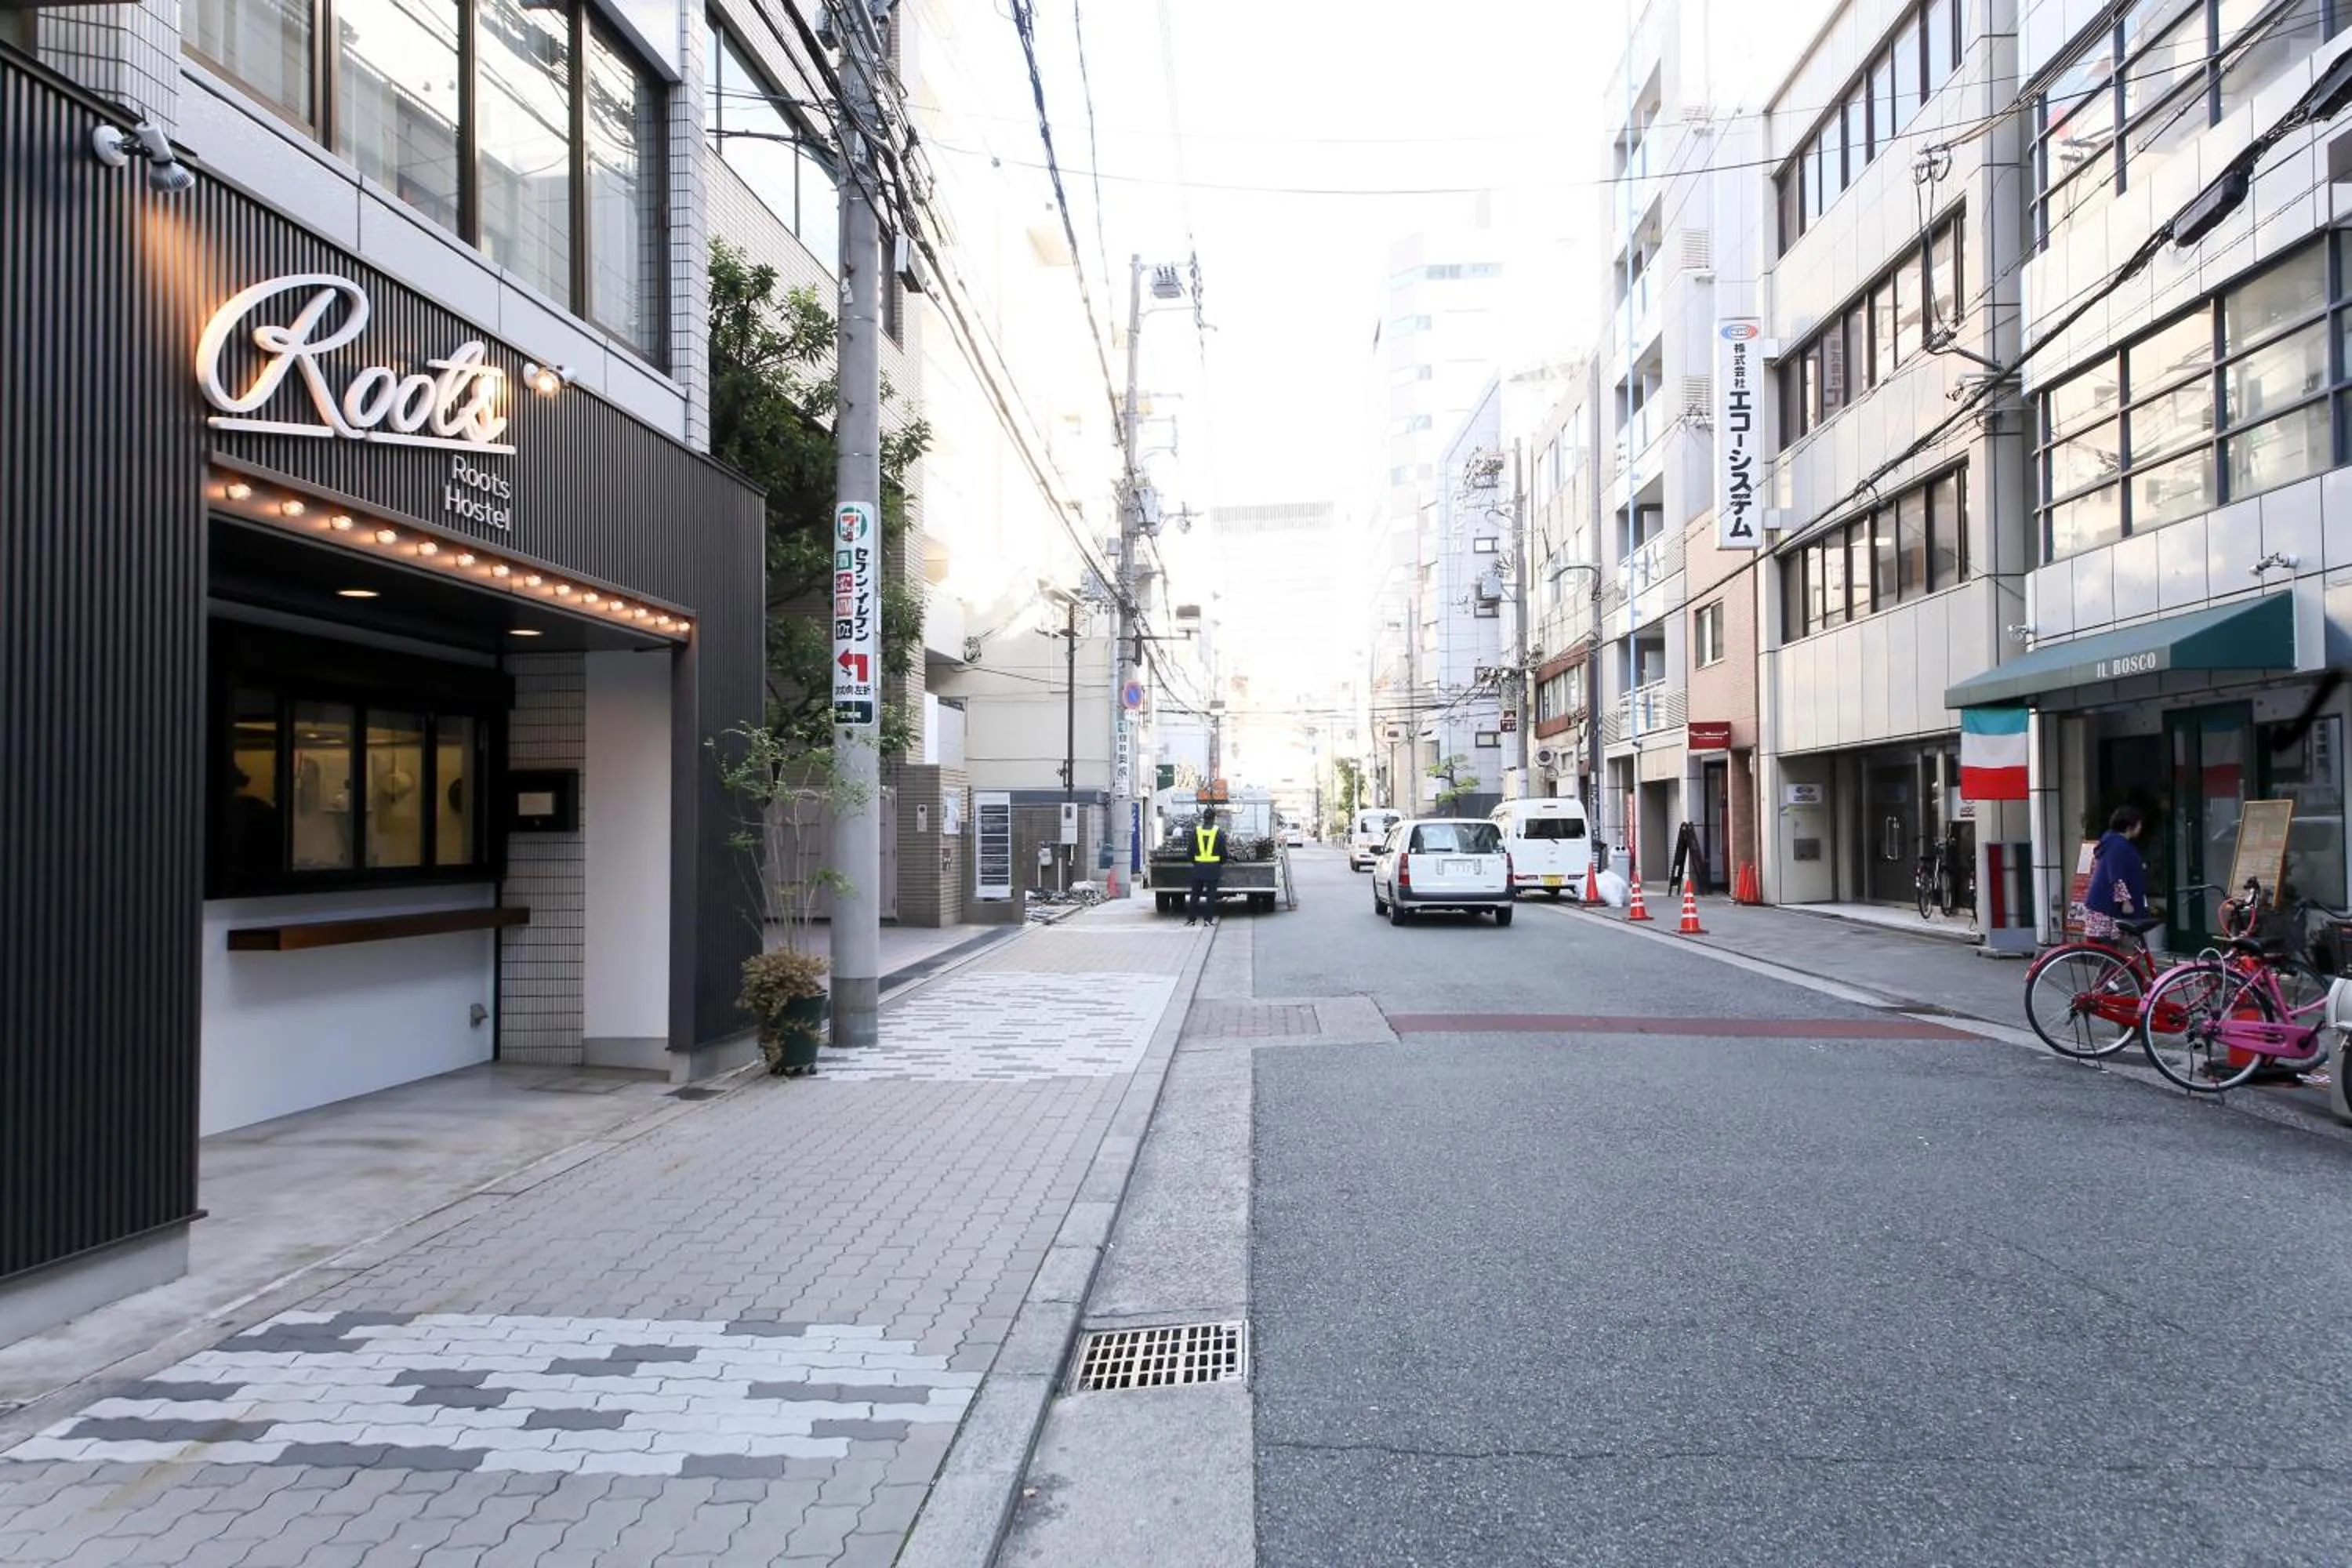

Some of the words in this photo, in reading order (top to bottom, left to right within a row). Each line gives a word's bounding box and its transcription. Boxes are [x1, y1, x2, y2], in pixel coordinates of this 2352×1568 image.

[196, 274, 507, 441] Roots
[452, 454, 511, 500] Roots
[445, 484, 511, 531] Hostel
[2096, 662, 2108, 678] IL
[2113, 652, 2156, 675] BOSCO
